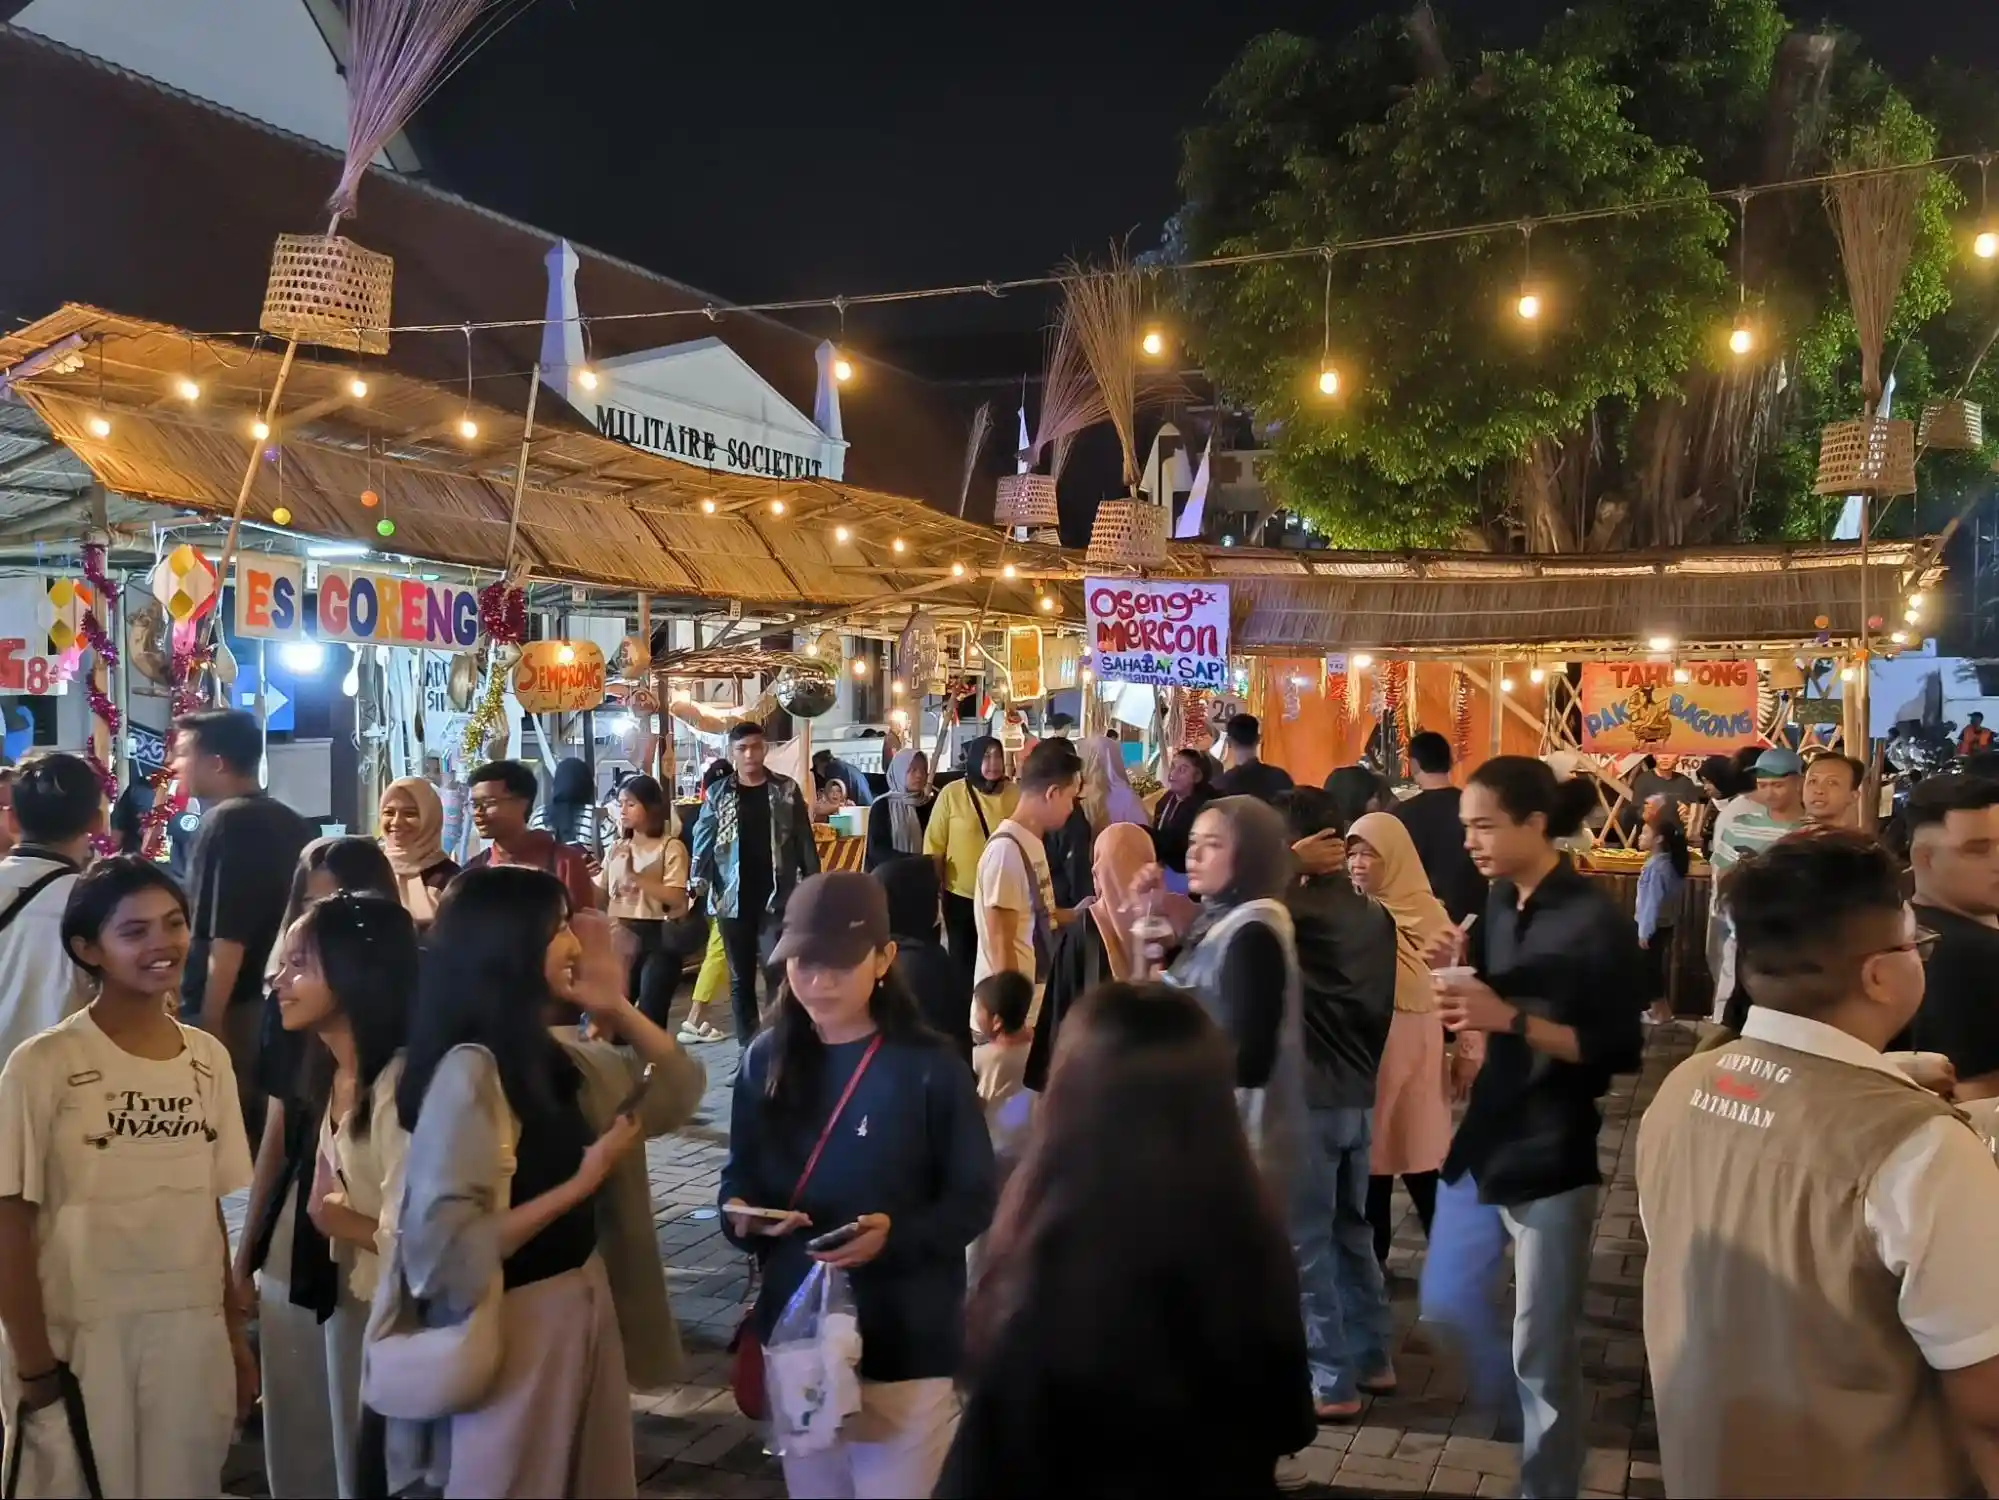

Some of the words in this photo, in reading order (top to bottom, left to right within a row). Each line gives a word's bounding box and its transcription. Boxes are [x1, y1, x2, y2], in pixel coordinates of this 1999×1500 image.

[596, 404, 715, 462] MILITAIRE
[246, 569, 296, 629] ES
[319, 574, 478, 646] GORENG
[518, 652, 601, 705] SEMPRONG
[1610, 664, 1675, 689] TAHU
[1585, 698, 1630, 739] PAK
[1669, 692, 1753, 738] BAGONG
[120, 1090, 194, 1114] True
[1689, 1088, 1776, 1128] RATMAKAN
